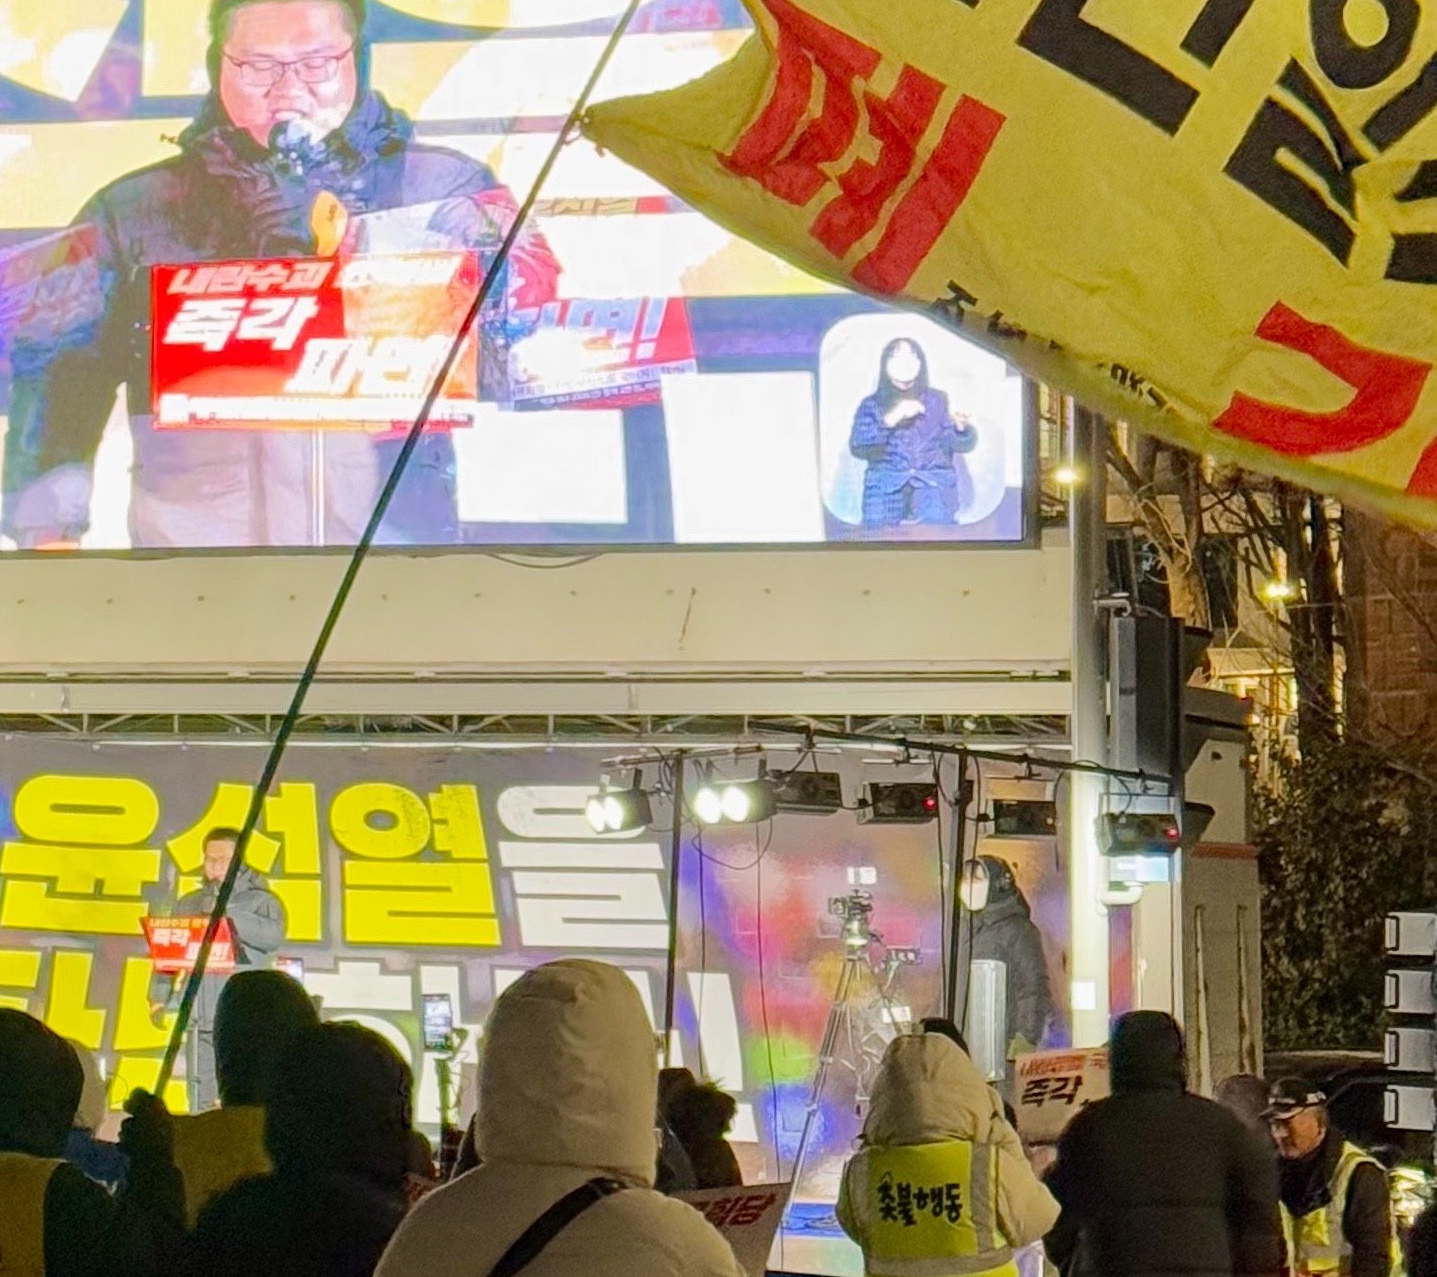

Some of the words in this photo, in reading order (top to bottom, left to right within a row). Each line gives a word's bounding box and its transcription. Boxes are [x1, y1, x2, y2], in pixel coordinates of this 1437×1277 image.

[163, 295, 319, 352] 즉각
[283, 335, 469, 399] 파면
[0, 773, 669, 951] 윤석열을
[1022, 1075, 1083, 1107] 즉각
[877, 1170, 963, 1227] 촛불행동
